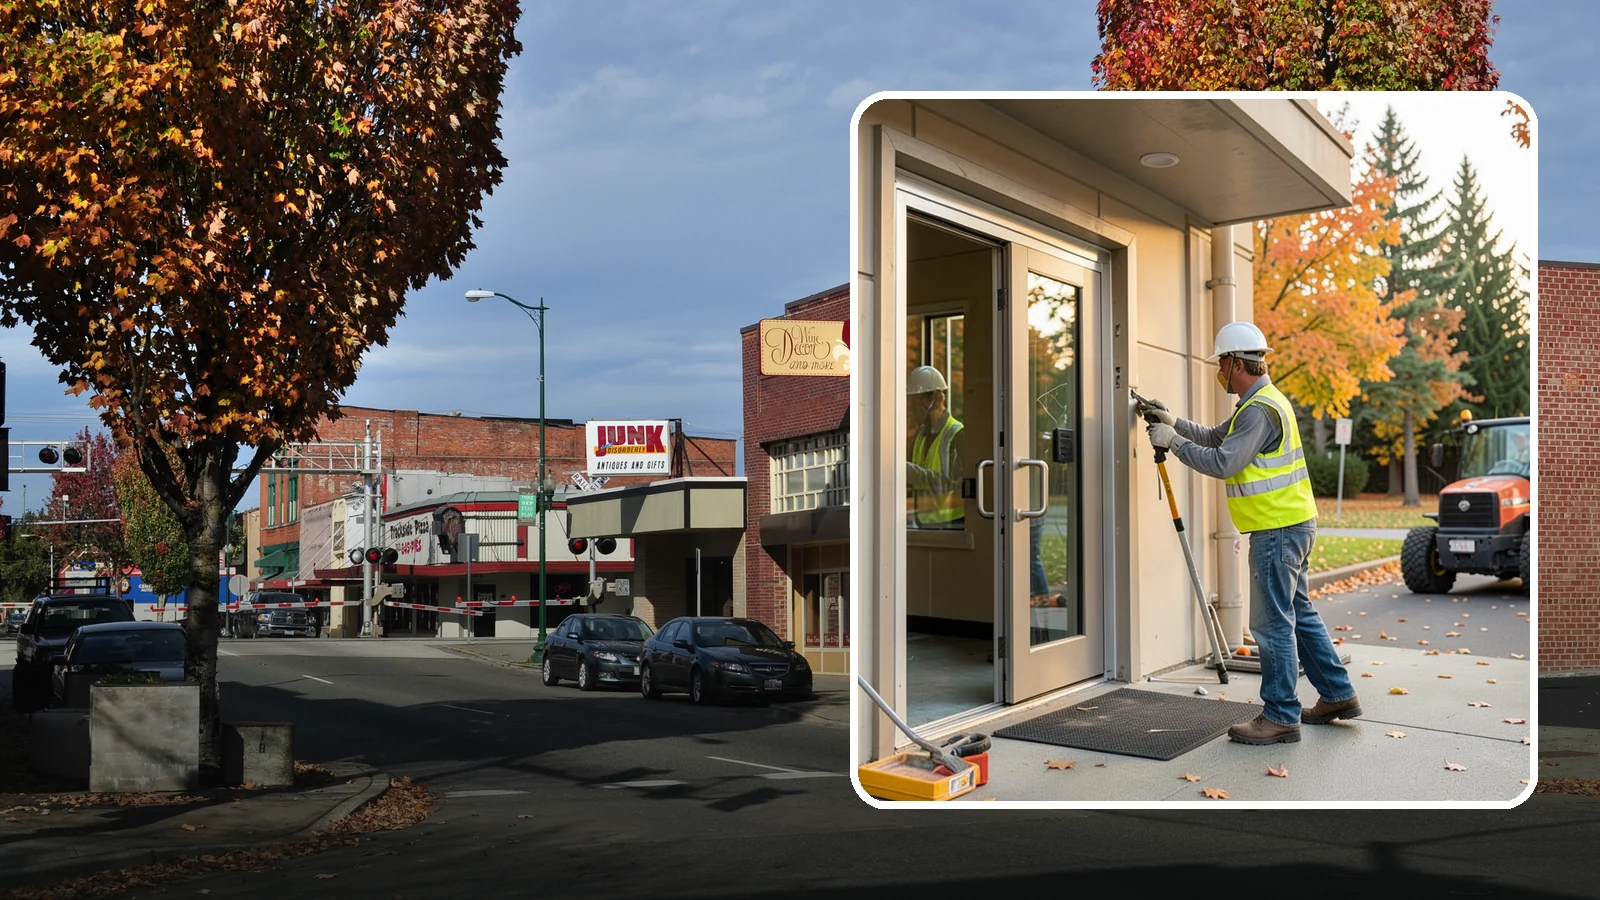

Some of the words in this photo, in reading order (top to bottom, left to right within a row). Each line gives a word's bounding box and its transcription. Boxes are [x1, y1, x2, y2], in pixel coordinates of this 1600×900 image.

[595, 425, 665, 457] JUNK
[607, 446, 646, 454] DISORDERLY
[597, 461, 628, 470] ANTIQUES
[631, 461, 644, 470] AND
[647, 460, 665, 469] GIFTS
[414, 519, 429, 535] Pizza
